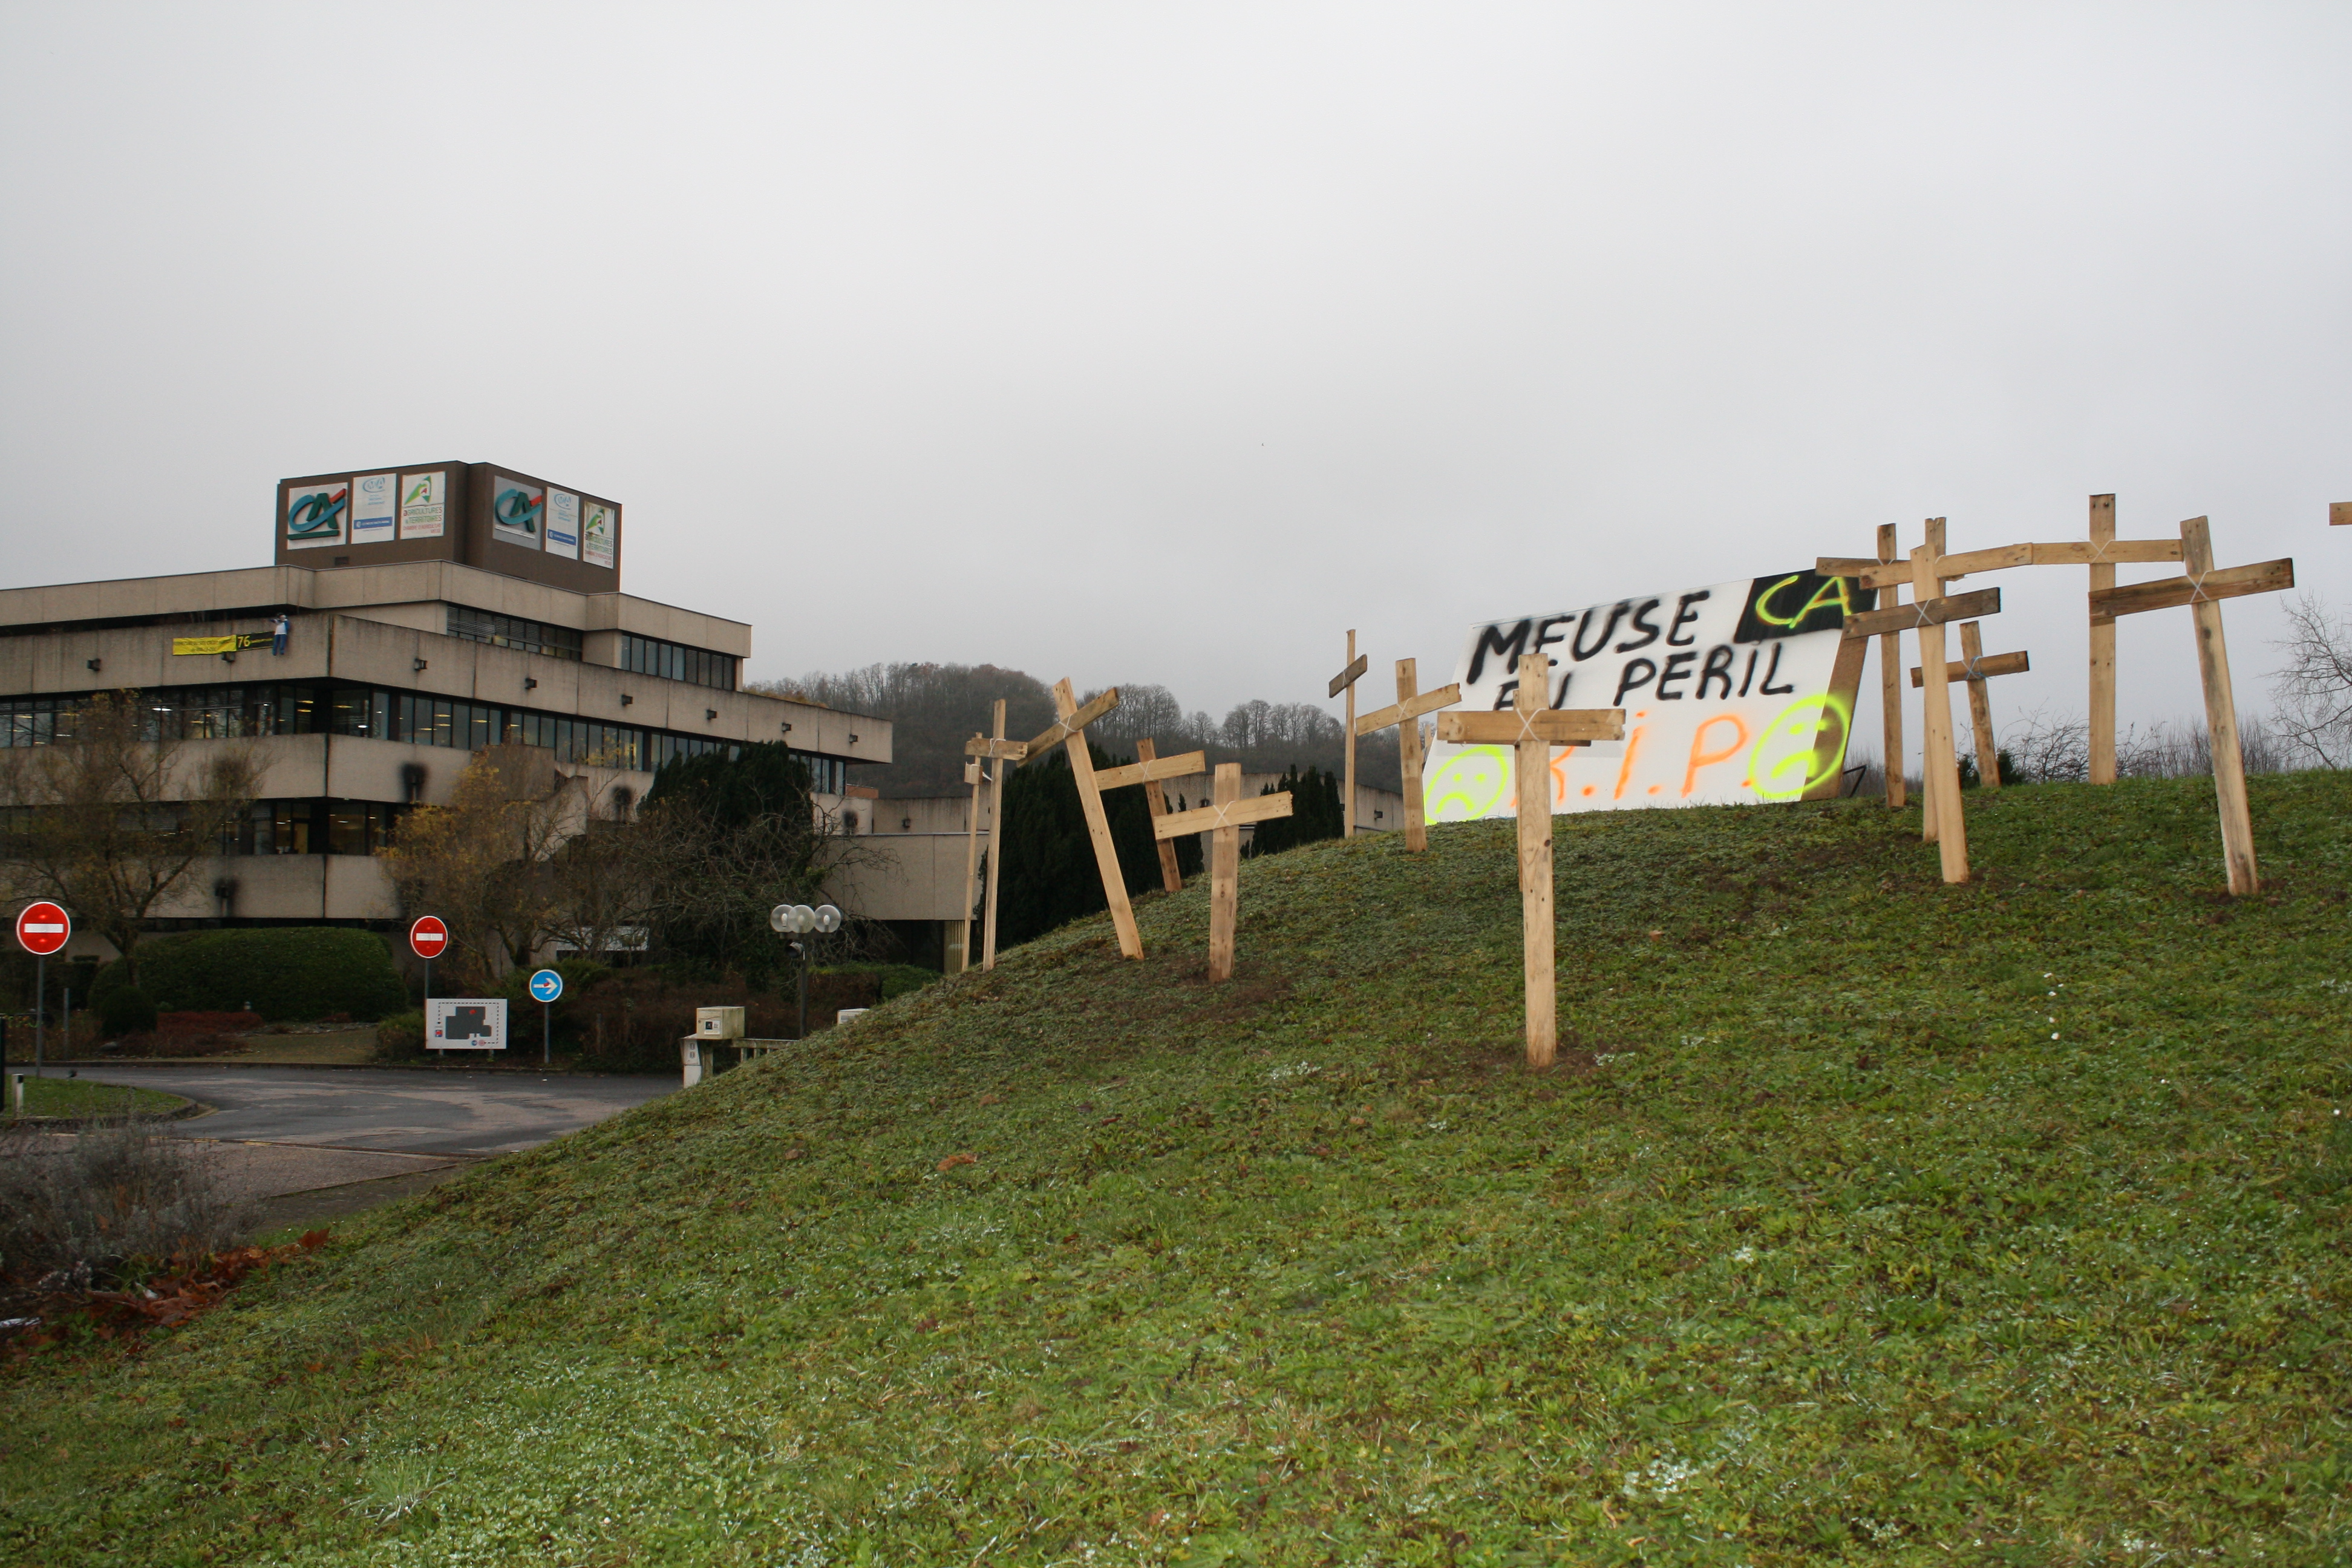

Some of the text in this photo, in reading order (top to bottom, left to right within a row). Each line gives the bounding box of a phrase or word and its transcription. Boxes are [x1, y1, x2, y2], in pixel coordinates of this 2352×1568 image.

[238, 635, 250, 648] 76
[1466, 575, 1853, 685] MEUSE CA
